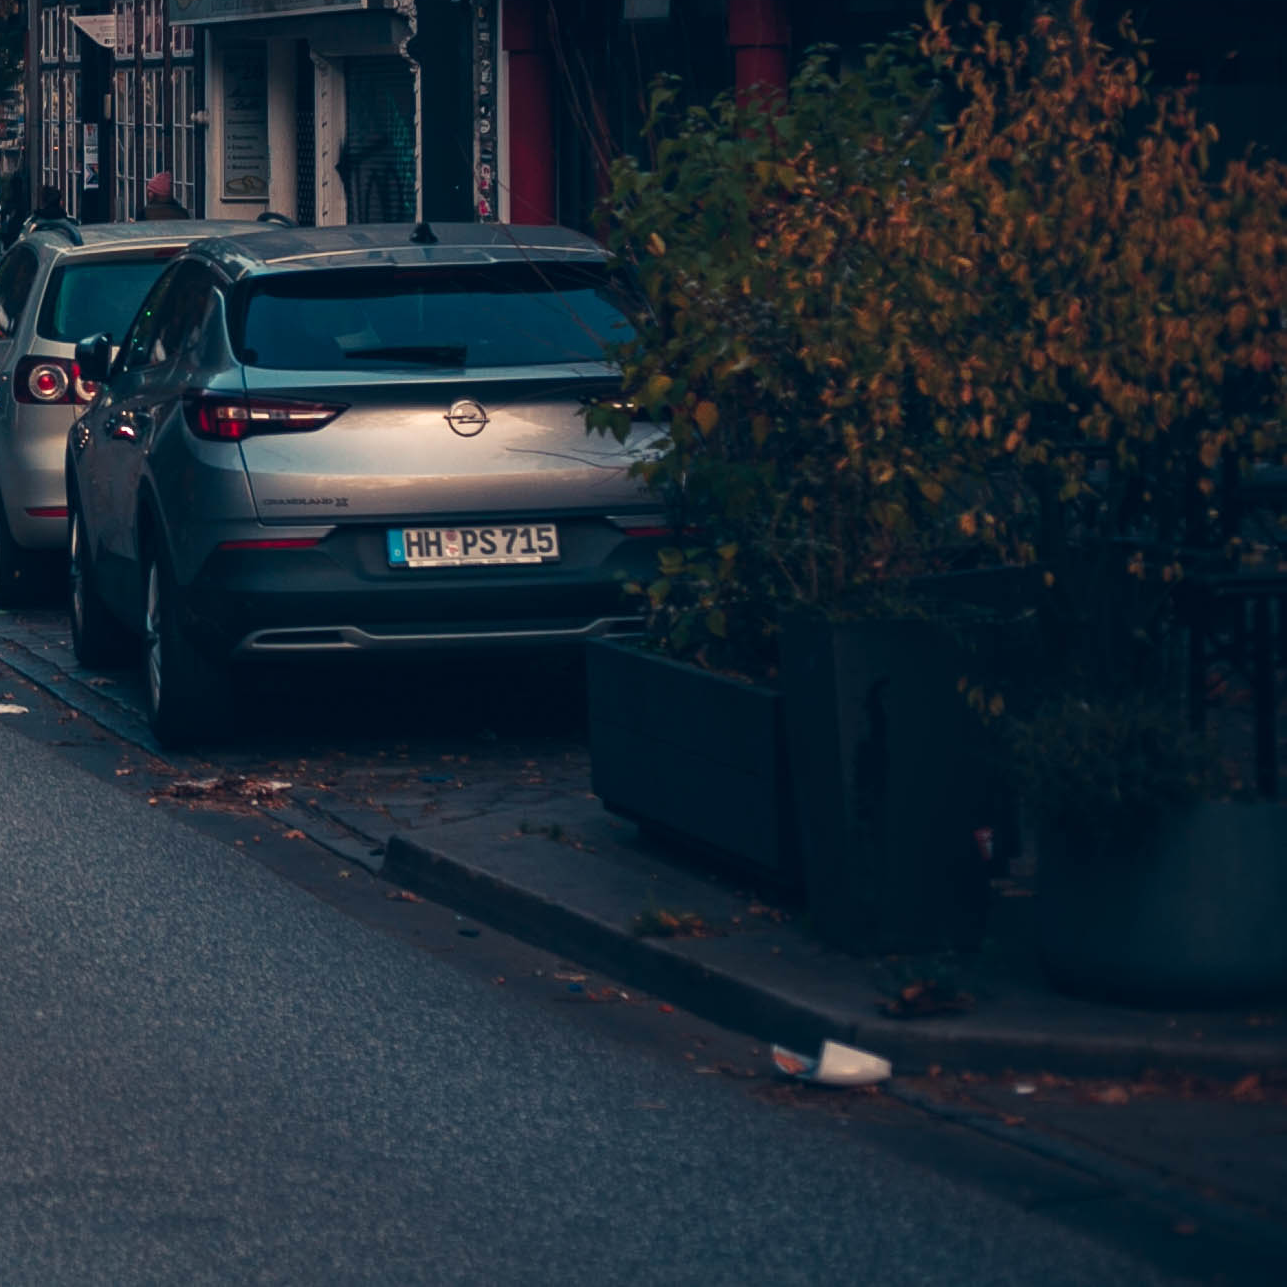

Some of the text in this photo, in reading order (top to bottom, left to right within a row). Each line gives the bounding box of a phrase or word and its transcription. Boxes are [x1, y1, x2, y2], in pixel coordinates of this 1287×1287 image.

[405, 527, 554, 558] HH PS 715
